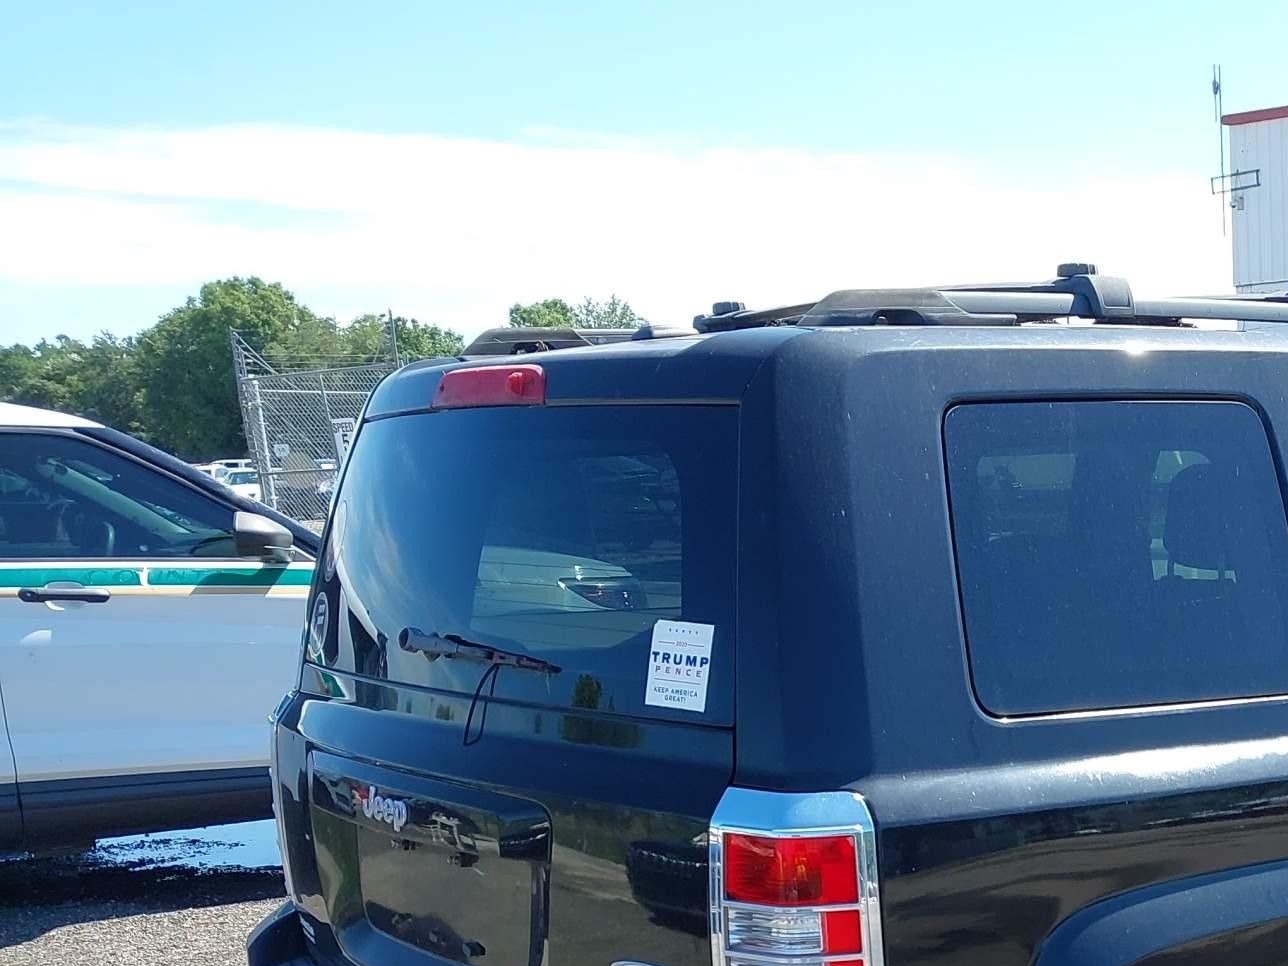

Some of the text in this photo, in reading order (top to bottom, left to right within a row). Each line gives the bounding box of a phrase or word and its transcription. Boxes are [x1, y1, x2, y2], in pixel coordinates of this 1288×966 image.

[332, 422, 354, 434] SPEED
[651, 651, 709, 668] TRUMP
[655, 665, 702, 678] PENCE
[653, 686, 698, 698] KEEP AMERICA
[664, 694, 687, 703] GREAT!
[362, 785, 408, 833] Jeep
